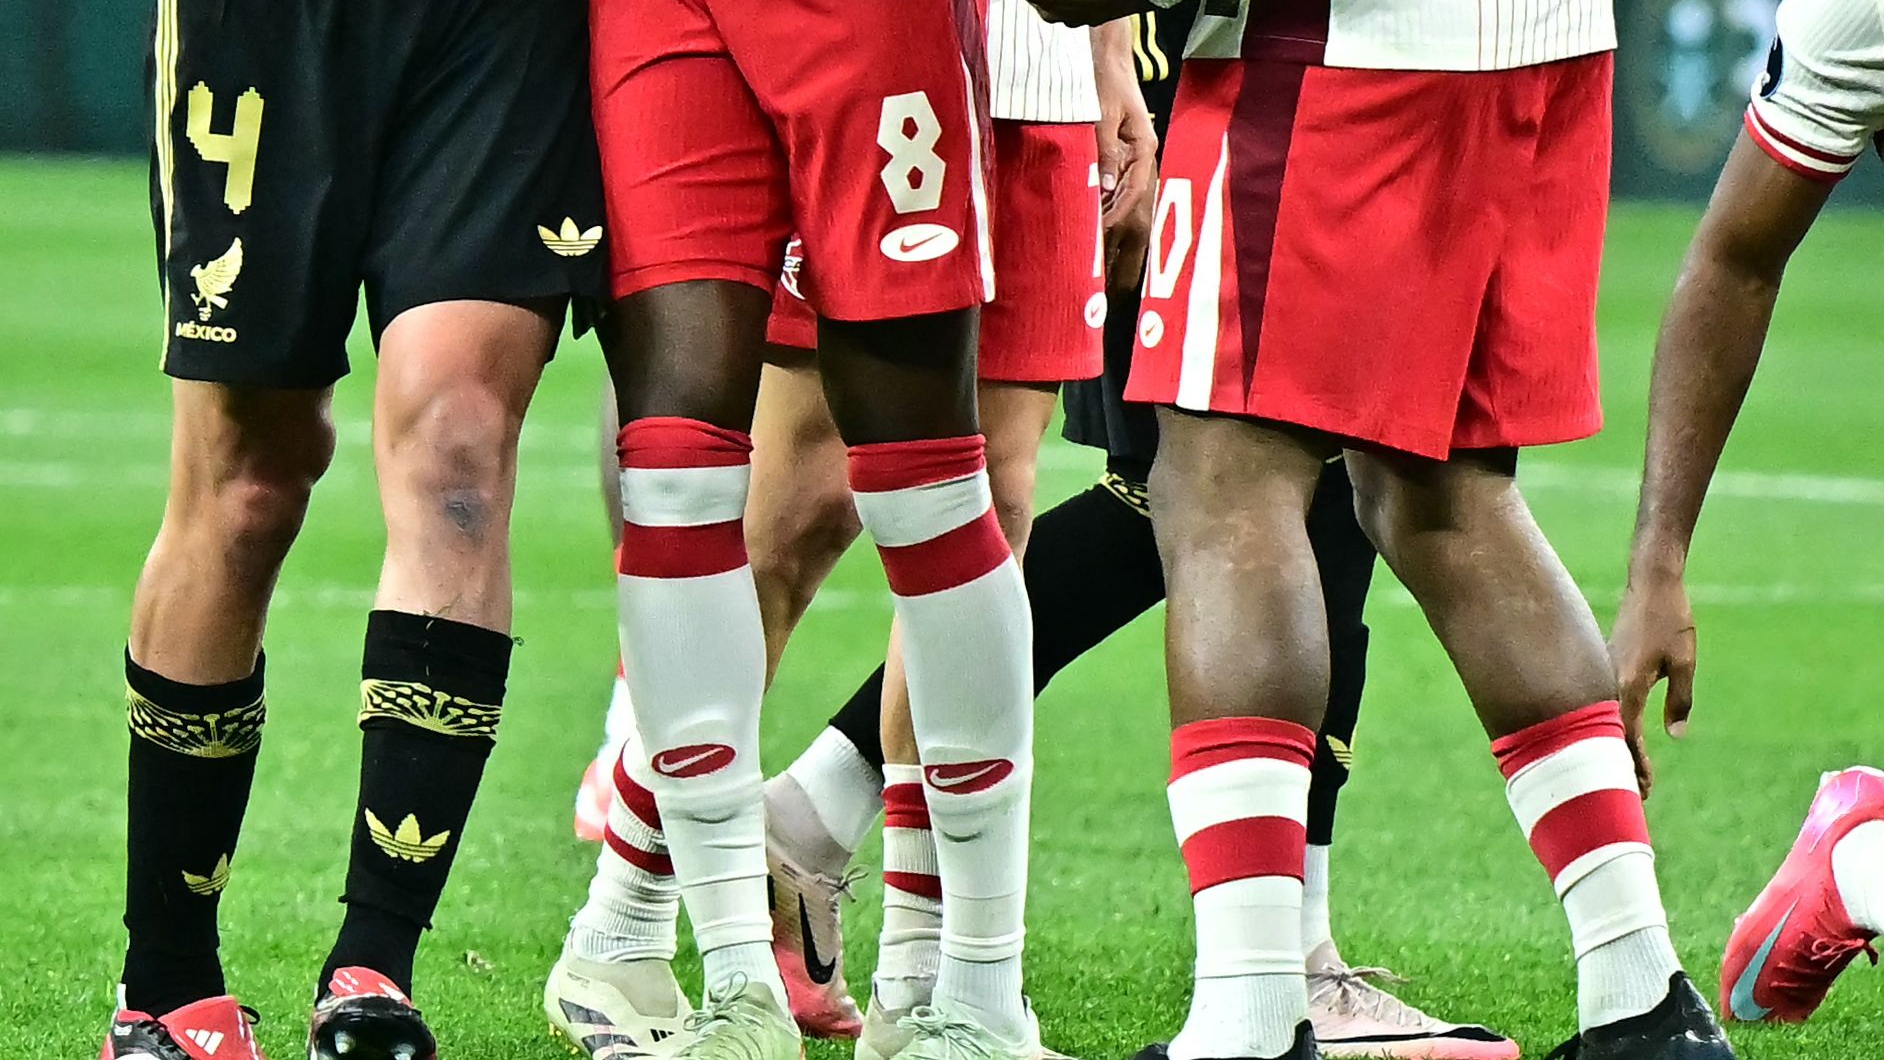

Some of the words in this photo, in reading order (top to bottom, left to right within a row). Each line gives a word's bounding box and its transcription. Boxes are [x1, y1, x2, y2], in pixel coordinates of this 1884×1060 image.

[186, 80, 265, 215] 4
[876, 91, 947, 214] 8
[175, 320, 238, 343] MÉXICO
